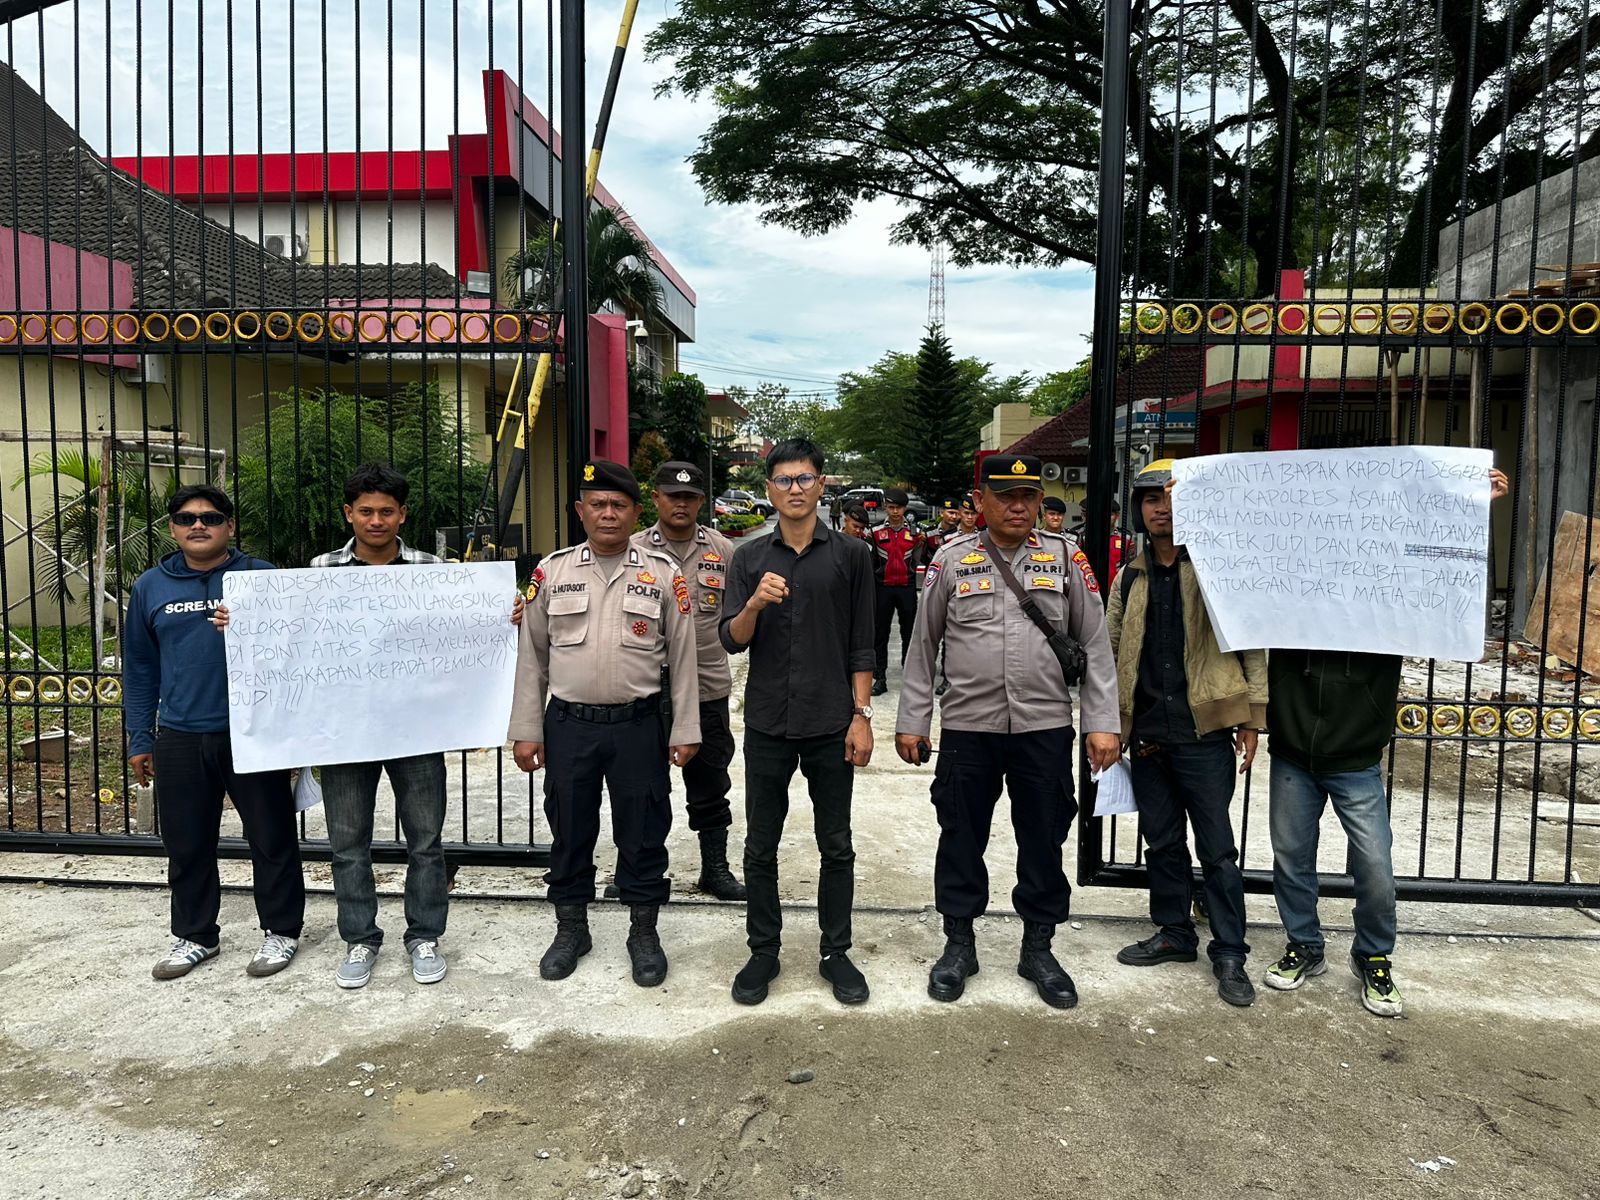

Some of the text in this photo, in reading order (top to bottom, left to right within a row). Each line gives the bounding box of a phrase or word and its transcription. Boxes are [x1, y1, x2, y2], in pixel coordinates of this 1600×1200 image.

[1184, 462, 1274, 484] MEMINTA
[1278, 460, 1341, 485] BAPAK
[1346, 457, 1426, 480] KAPOLDA
[1176, 485, 1477, 516] COPOT KAPOLRES ASAHAN KARENA
[1175, 507, 1229, 527] SUDAH
[1234, 508, 1303, 530] MENUP
[1306, 509, 1354, 532] MATA
[1360, 512, 1427, 538] DENGAN
[1262, 532, 1308, 555] JUDI
[1314, 536, 1351, 558] DAN
[1356, 537, 1400, 558] KAMI
[697, 562, 726, 572] POLRI
[1023, 564, 1062, 574] POLRI
[1195, 553, 1262, 574] ENDUGA
[1262, 554, 1325, 577] TELAH
[1421, 567, 1482, 600] DALAM
[238, 572, 341, 594] MENDESAK
[343, 570, 408, 592] BAPAK
[411, 567, 477, 591] KAPOLDA
[627, 584, 661, 599] POLRI
[164, 599, 223, 614] SCREAM
[228, 591, 508, 616] SUMUT AGAR TERJUN LANGSUNG
[1299, 577, 1347, 601] DARI
[1353, 585, 1406, 608] MAFIA
[1408, 589, 1450, 616] JUDI
[227, 617, 307, 638] KELOKASI
[310, 617, 368, 637] YANG
[374, 614, 425, 636] YANG
[426, 613, 467, 633] KAMI
[228, 633, 517, 666] DI POINT ATAS SERTA MELAKUKAN
[228, 662, 364, 690] PENANGKAPAN
[365, 657, 428, 681] KEPADA
[229, 689, 273, 707] JUDI
